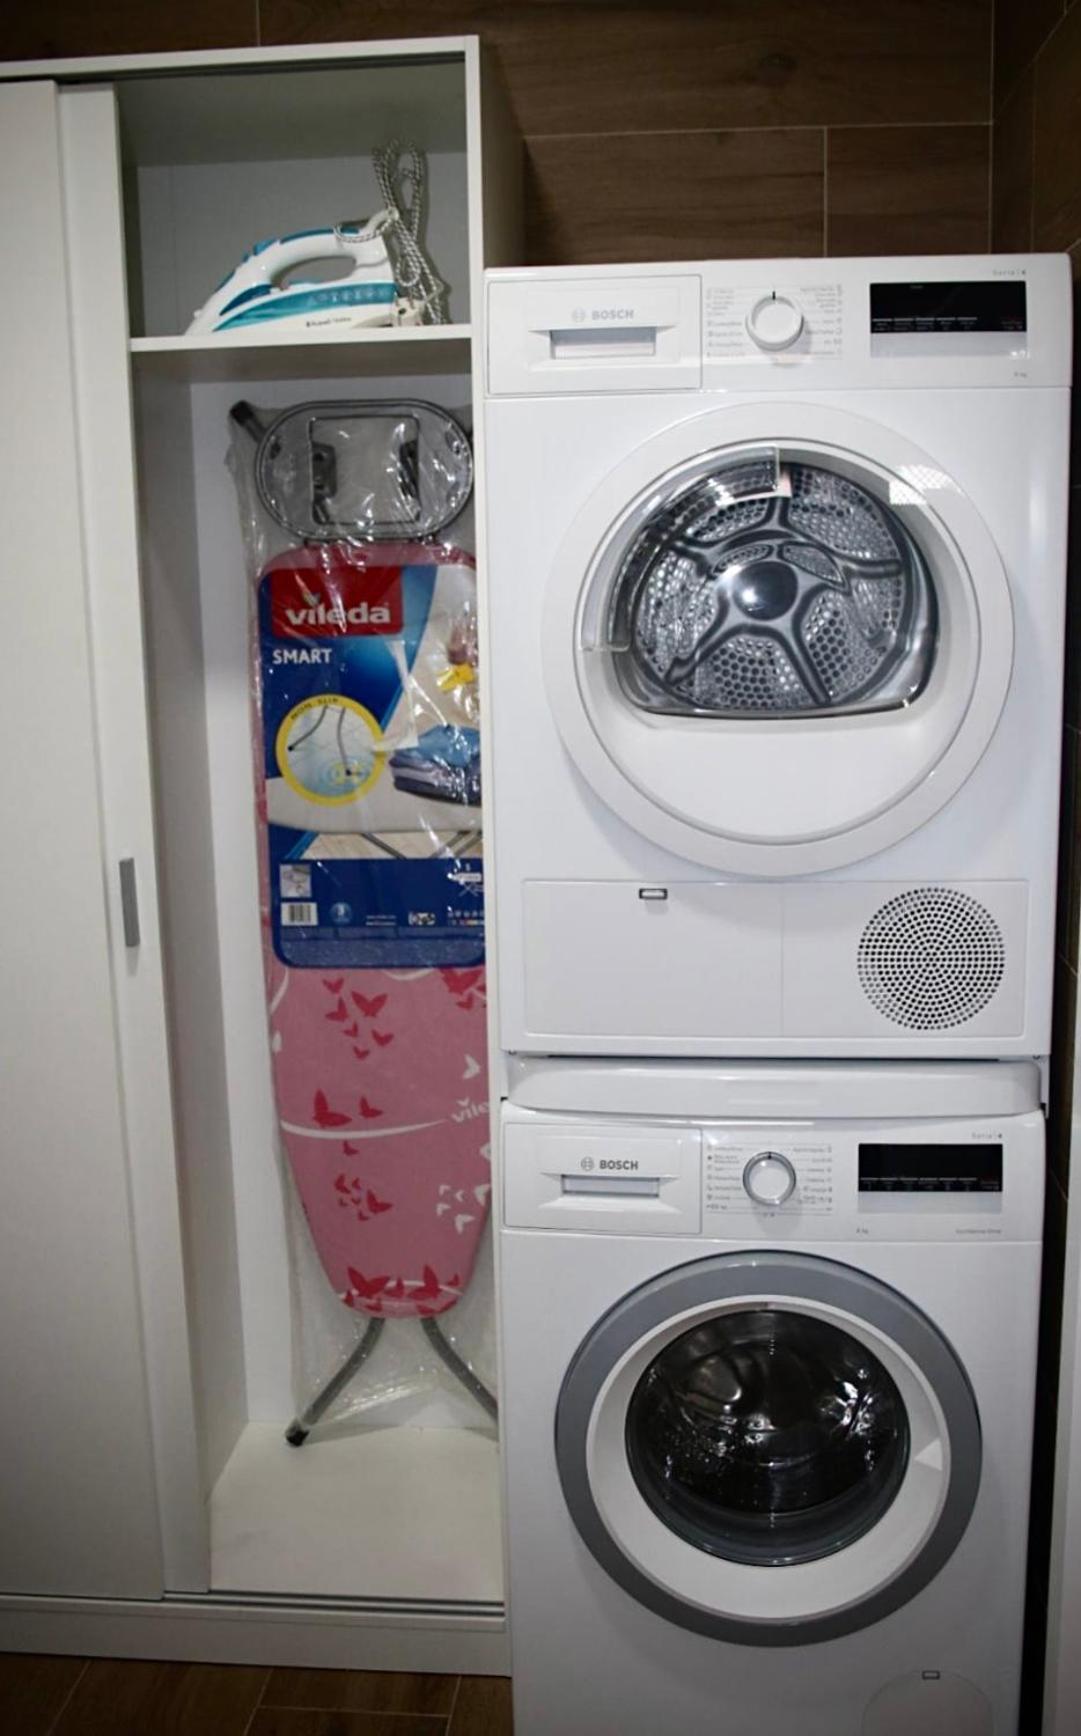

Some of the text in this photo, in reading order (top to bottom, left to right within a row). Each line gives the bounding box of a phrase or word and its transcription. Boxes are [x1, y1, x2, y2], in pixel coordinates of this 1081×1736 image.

[591, 309, 635, 321] BOSCH
[285, 600, 391, 626] vileda
[272, 649, 332, 664] SMART
[599, 1160, 639, 1171] BOSCH
